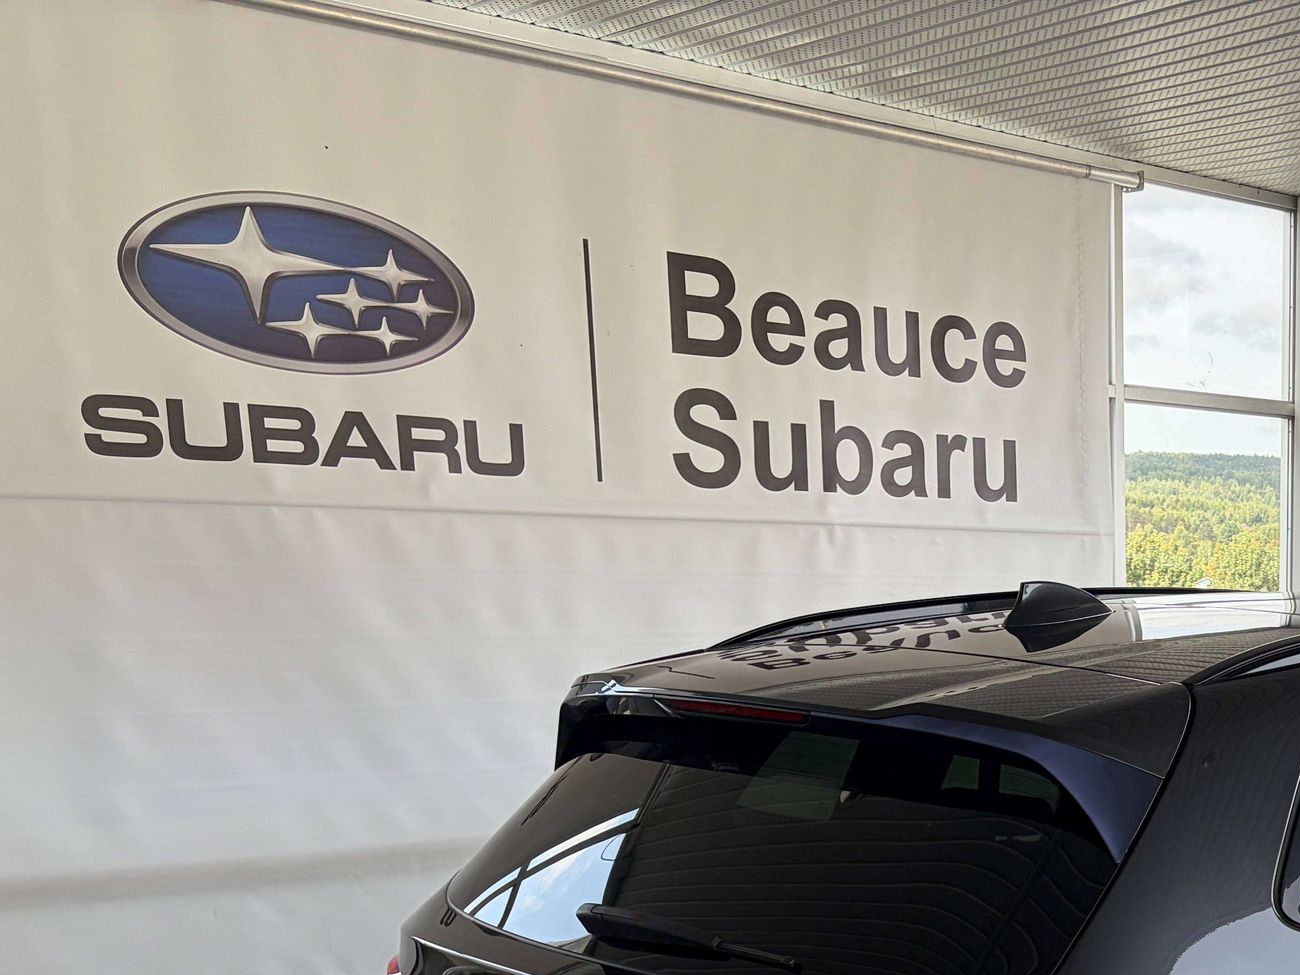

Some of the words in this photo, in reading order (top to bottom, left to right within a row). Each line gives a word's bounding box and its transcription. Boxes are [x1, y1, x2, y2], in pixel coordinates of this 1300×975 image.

[667, 251, 1027, 388] Beauce
[81, 395, 524, 476] SUBARU
[673, 388, 1018, 502] Subaru
